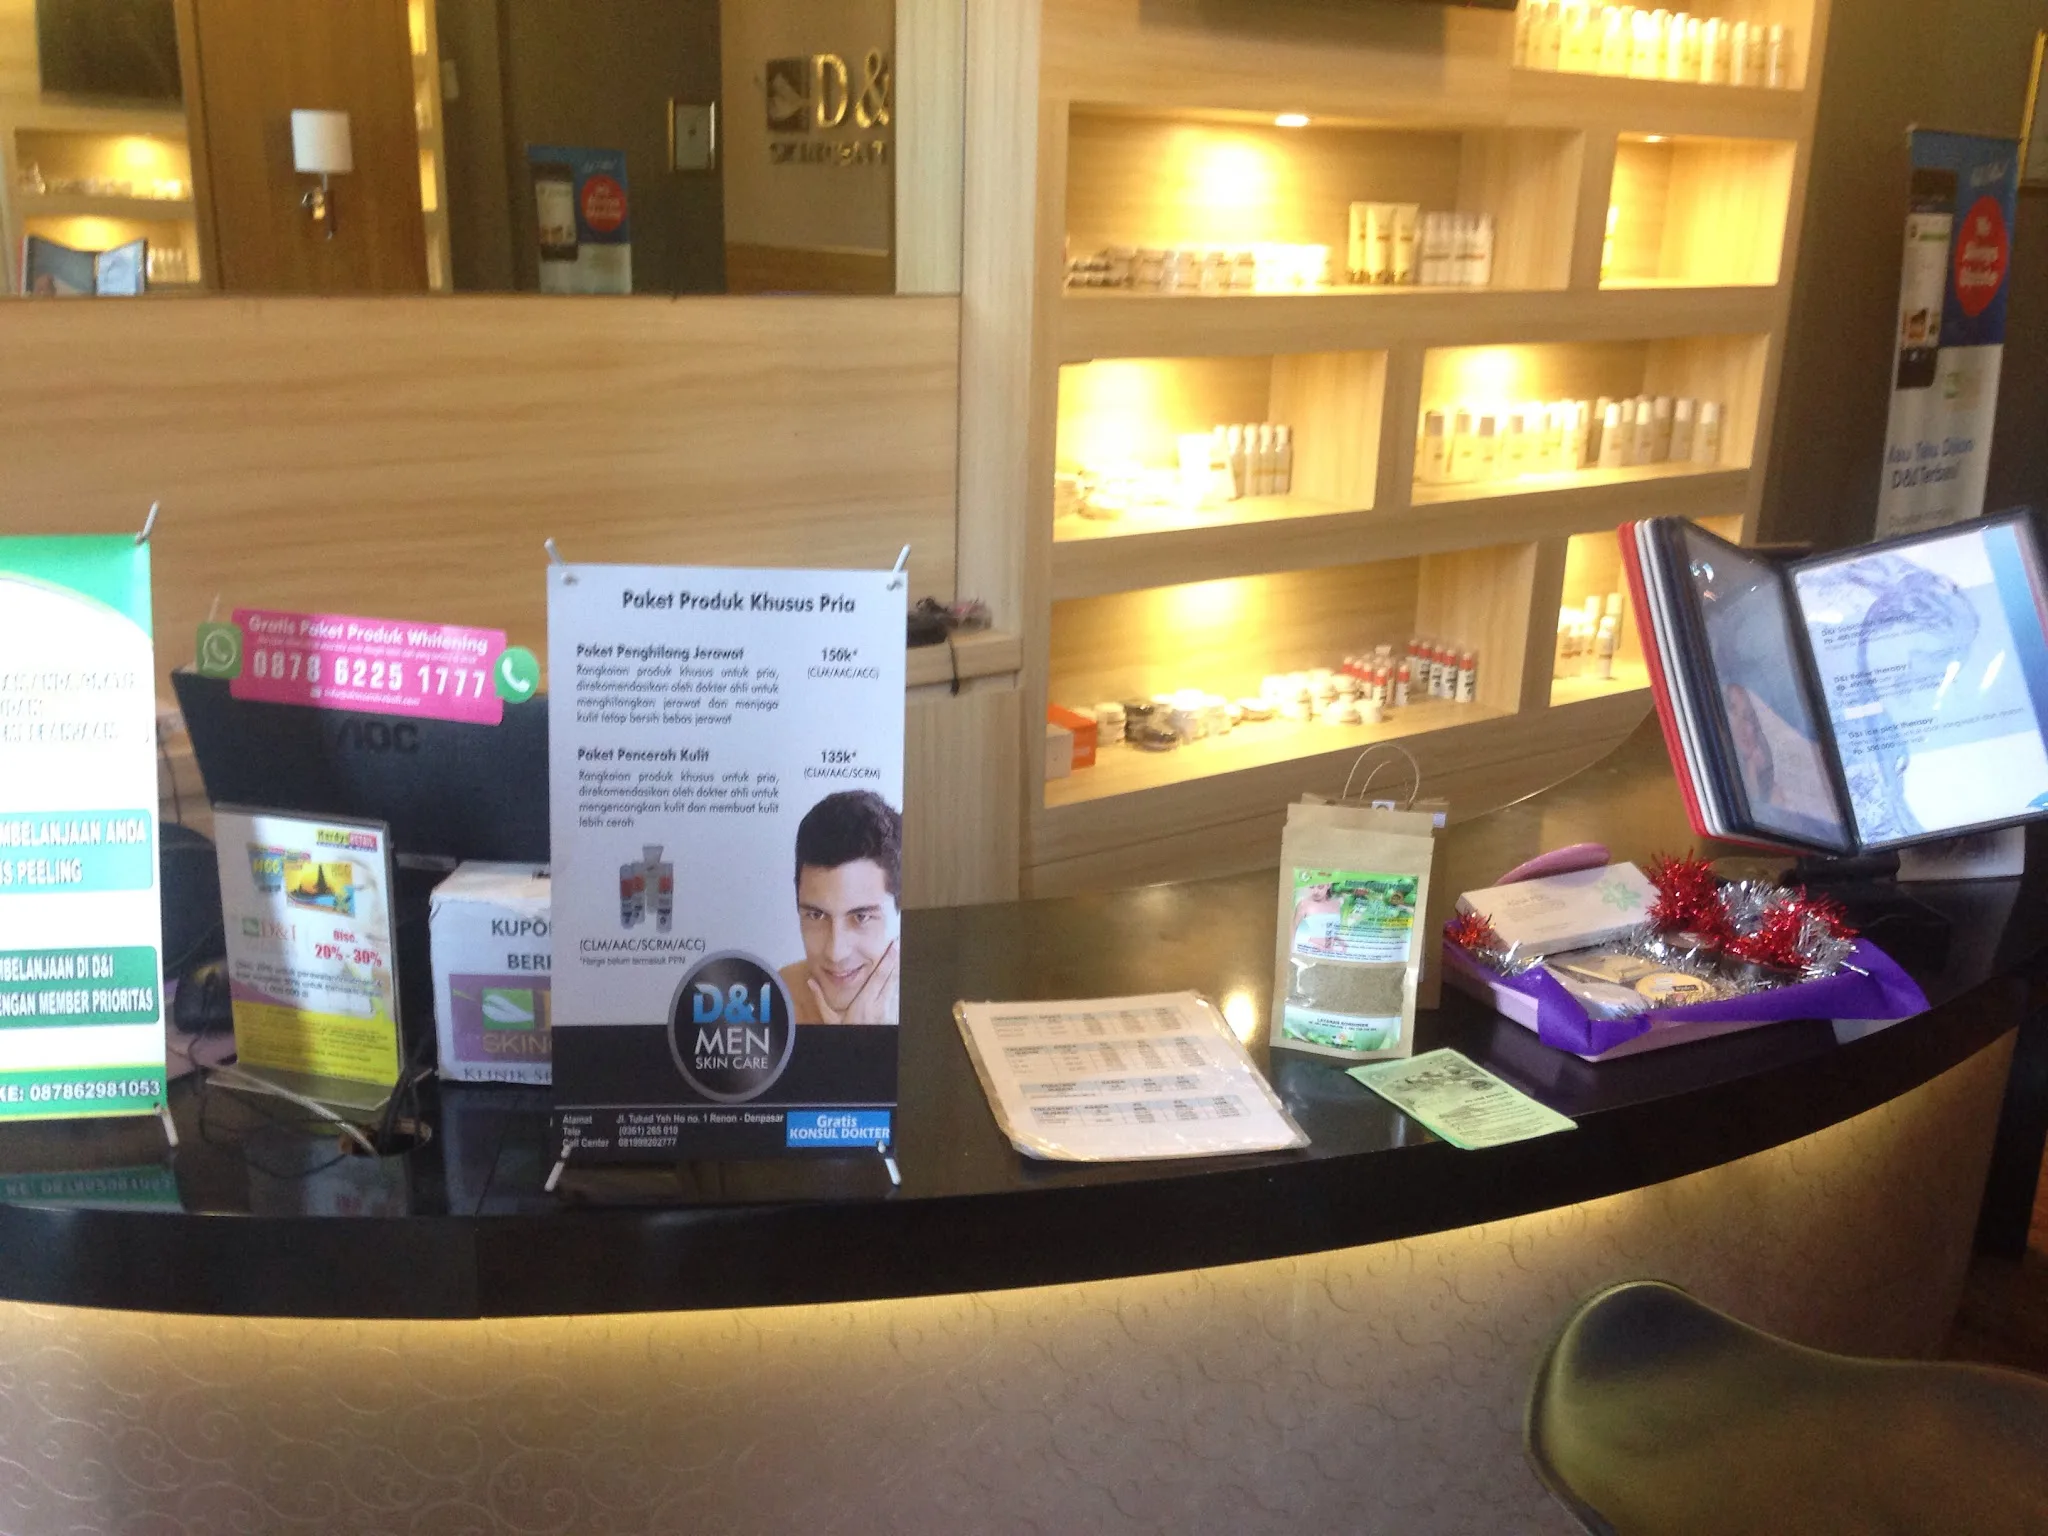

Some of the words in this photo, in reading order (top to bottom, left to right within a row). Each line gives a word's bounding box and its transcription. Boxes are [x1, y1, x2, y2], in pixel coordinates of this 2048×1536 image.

[622, 589, 674, 609] Paket
[679, 590, 744, 611] Produk
[750, 592, 814, 612] Khusus
[820, 593, 856, 613] Pria
[248, 615, 295, 635] Gratis
[299, 619, 343, 639] Paket
[347, 623, 403, 645] Produk
[407, 628, 488, 656] Whitening
[576, 644, 612, 658] Paket
[617, 644, 690, 662] Penghilang
[693, 646, 745, 660] Jerawat
[253, 649, 321, 684] 0878
[334, 656, 403, 691] 6225
[417, 664, 486, 699] 1777
[576, 663, 629, 678] Rangkaian
[636, 665, 672, 680] produk
[680, 665, 713, 678] khusus
[721, 666, 748, 678] untuk
[576, 680, 669, 693] direkomendasikan
[671, 681, 692, 693] oleh
[695, 681, 727, 693] dokter
[730, 682, 748, 693] ahli
[751, 683, 779, 694] untuk
[576, 696, 656, 712] menghilangkan
[663, 697, 700, 711] jerawat
[708, 698, 728, 709] dan
[735, 699, 779, 712] menjaga
[576, 712, 598, 723] kulit
[601, 712, 627, 725] tetap
[629, 712, 659, 724] bersih
[662, 713, 692, 724] bebas
[695, 713, 732, 727] jerawat
[577, 747, 613, 761] Paket
[617, 747, 676, 762] Pencerah
[680, 748, 709, 762] Kulit
[578, 770, 630, 784] Rangkaian
[638, 771, 673, 785] produk
[680, 771, 714, 783] khusus
[722, 771, 749, 783] untuk
[578, 786, 669, 798] direkomendasikan
[672, 786, 694, 798] oleh
[696, 787, 727, 798] dokter
[730, 787, 748, 798] ahli
[751, 787, 779, 798] untuk
[578, 801, 661, 815] mengencangkan
[663, 801, 685, 812] kulit
[687, 802, 707, 813] dan
[709, 802, 755, 813] membuat
[758, 802, 779, 813] kulit
[106, 818, 147, 844] ANDA
[578, 817, 603, 828] lebih
[606, 817, 634, 828] cerah
[17, 858, 83, 885] PEELING
[492, 919, 551, 937] KUPO
[580, 938, 706, 953] (CLM/AAC/SCRM/ACC)
[315, 944, 343, 961] 20%
[354, 948, 383, 967] 30%
[77, 955, 89, 979] DI
[92, 954, 114, 979] D&I
[39, 990, 90, 1014] MEMBER
[92, 987, 153, 1013] PRIORITAS
[693, 981, 771, 1023] D&I
[482, 1034, 548, 1054] SKIN
[694, 1026, 770, 1055] MEN
[695, 1056, 729, 1070] SKIN
[732, 1056, 768, 1070] CARE
[29, 1080, 161, 1101] 087862981053
[709, 1113, 737, 1124] Renon
[743, 1113, 784, 1125] Denpasar
[816, 1113, 857, 1128] Gratis
[789, 1127, 839, 1140] KONSUL
[841, 1127, 891, 1139] DOKTER
[581, 1137, 610, 1148] Center
